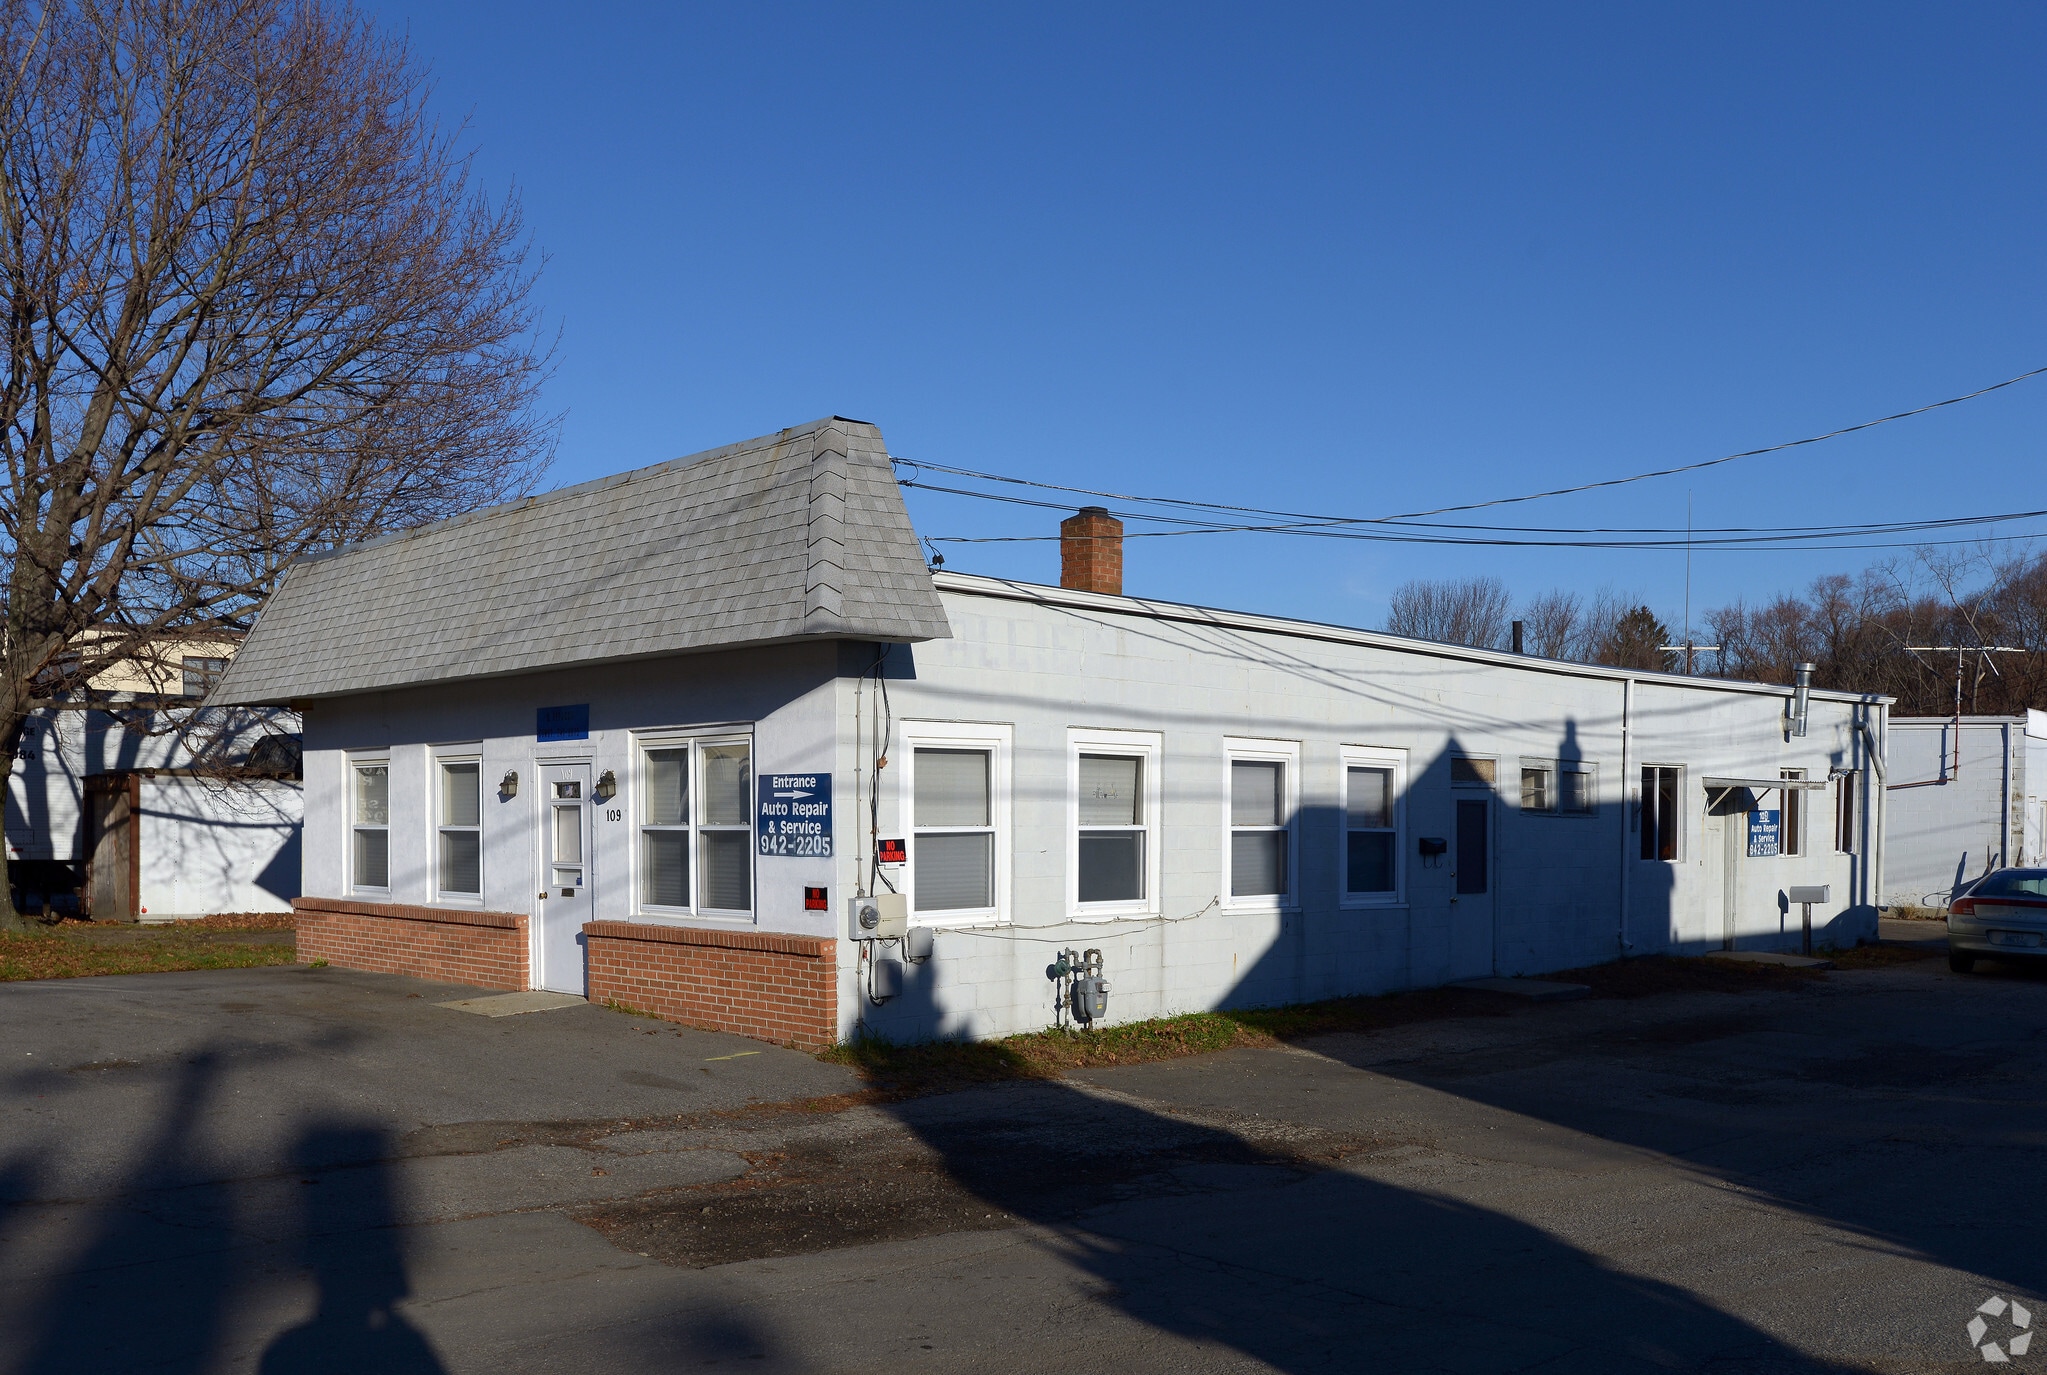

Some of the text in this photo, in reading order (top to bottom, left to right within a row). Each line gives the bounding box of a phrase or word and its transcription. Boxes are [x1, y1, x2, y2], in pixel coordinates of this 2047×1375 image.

[772, 776, 816, 788] Entrance
[606, 809, 621, 822] 109
[761, 801, 828, 818] Auto Repair
[768, 820, 822, 835] & Service
[1751, 824, 1778, 833] Auto Repair
[1758, 834, 1775, 843] Service
[760, 835, 831, 856] 942-2205
[885, 840, 896, 851] NO
[1750, 843, 1778, 855] 942-2205
[879, 850, 905, 862] PARKING
[805, 899, 826, 910] PARKING
